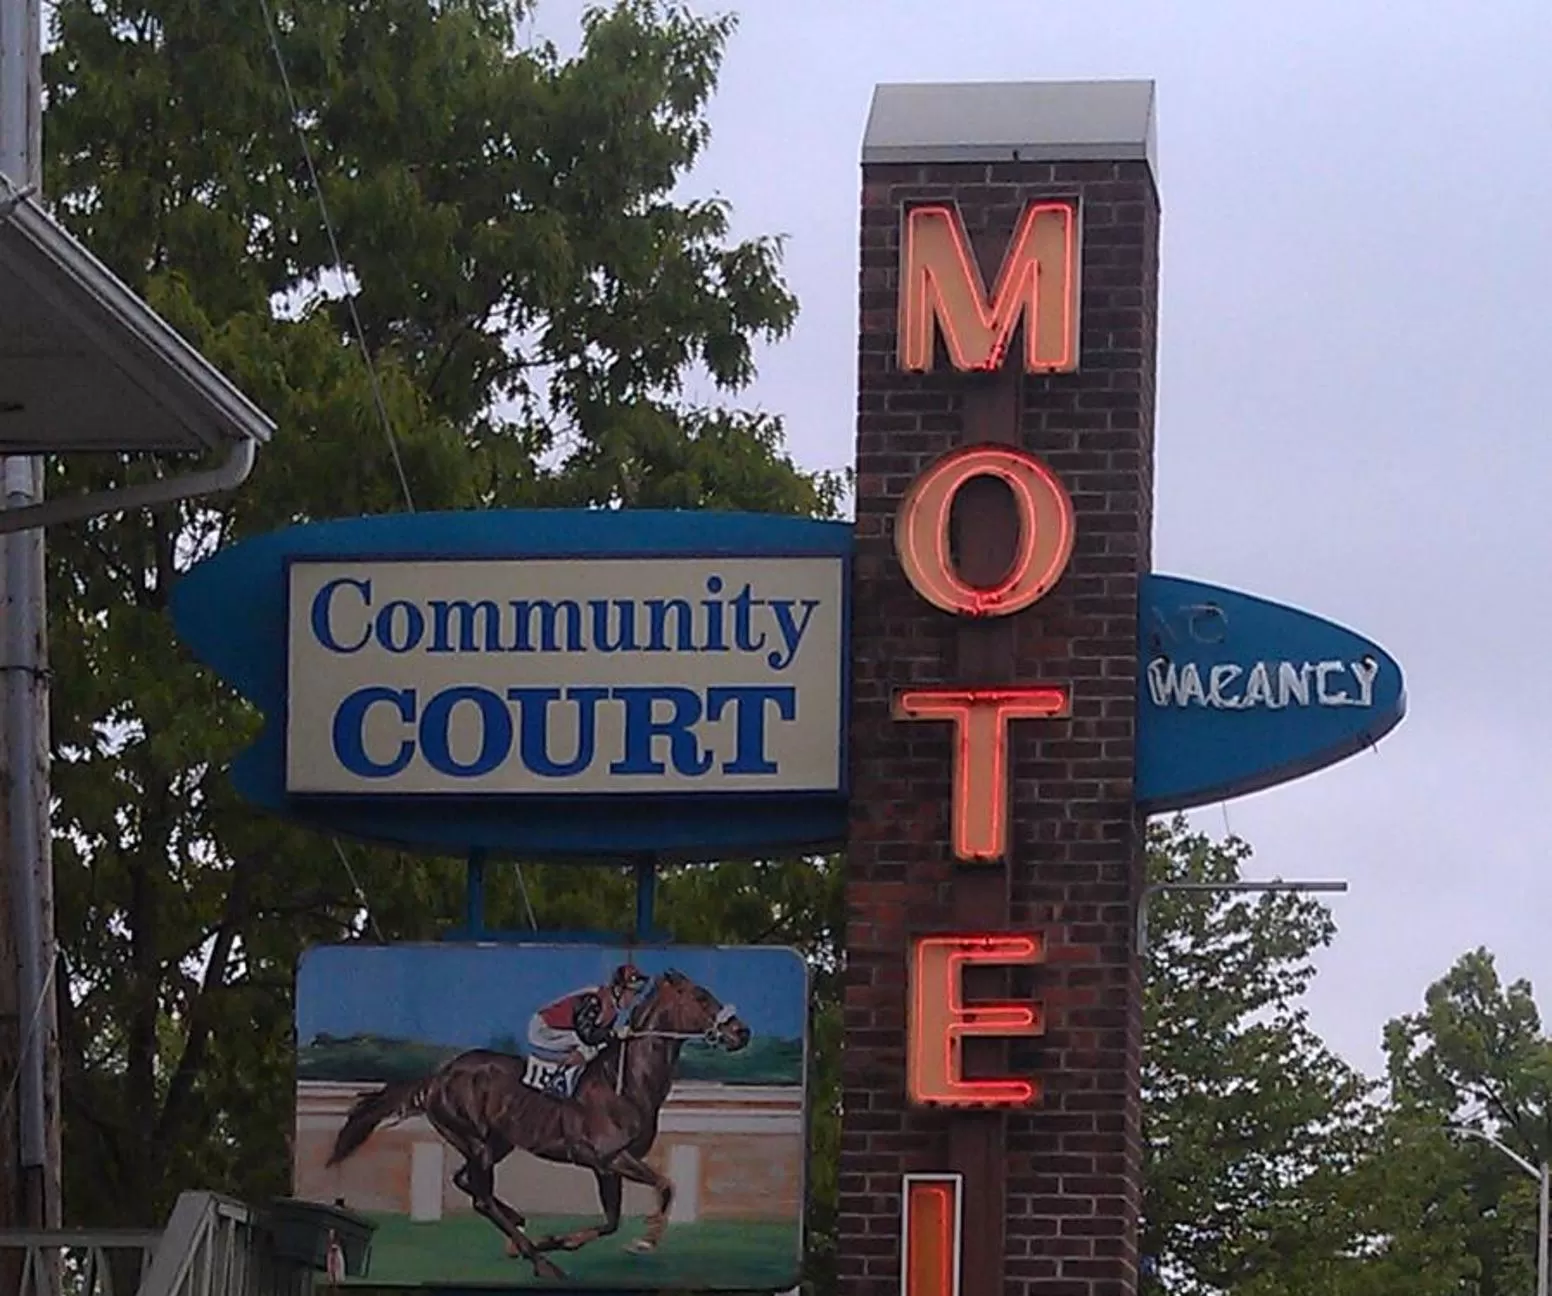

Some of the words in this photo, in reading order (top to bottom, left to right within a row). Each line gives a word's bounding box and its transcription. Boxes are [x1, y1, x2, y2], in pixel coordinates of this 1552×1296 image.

[311, 575, 819, 670] Community
[1147, 656, 1379, 709] VACANCY
[332, 685, 797, 778] COURT
